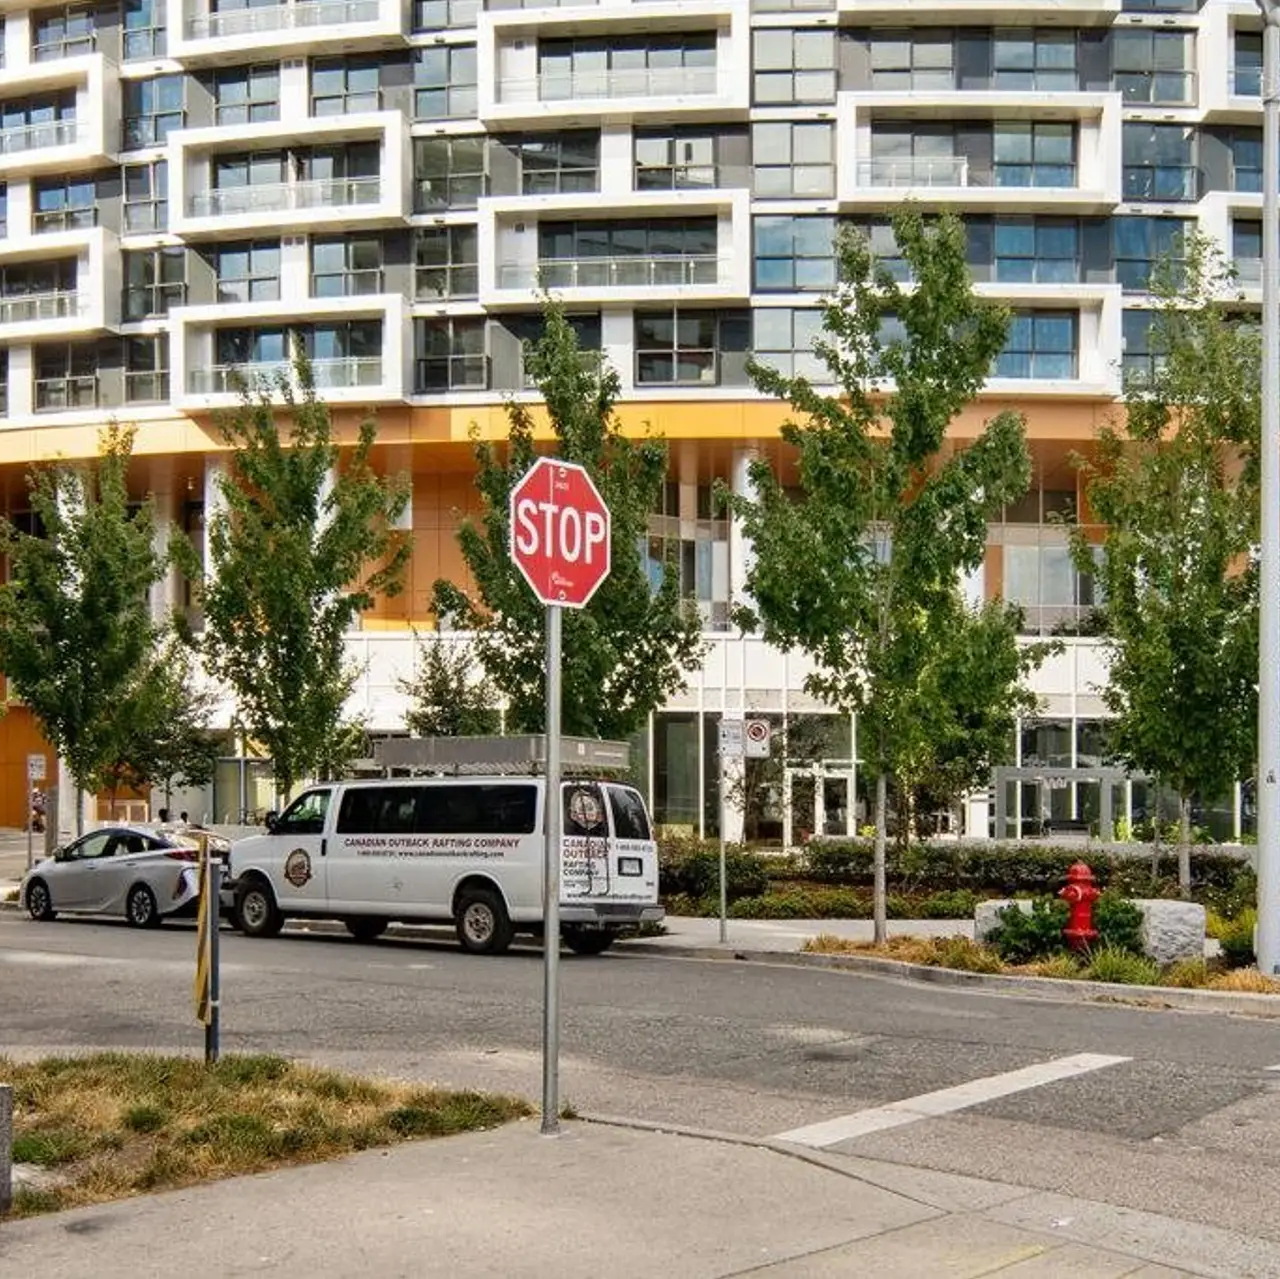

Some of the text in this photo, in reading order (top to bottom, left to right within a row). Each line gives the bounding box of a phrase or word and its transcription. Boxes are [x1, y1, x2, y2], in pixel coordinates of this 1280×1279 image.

[516, 498, 606, 565] STOP
[344, 837, 520, 848] CANADIAN OUTBACK RAFTING COMPANY
